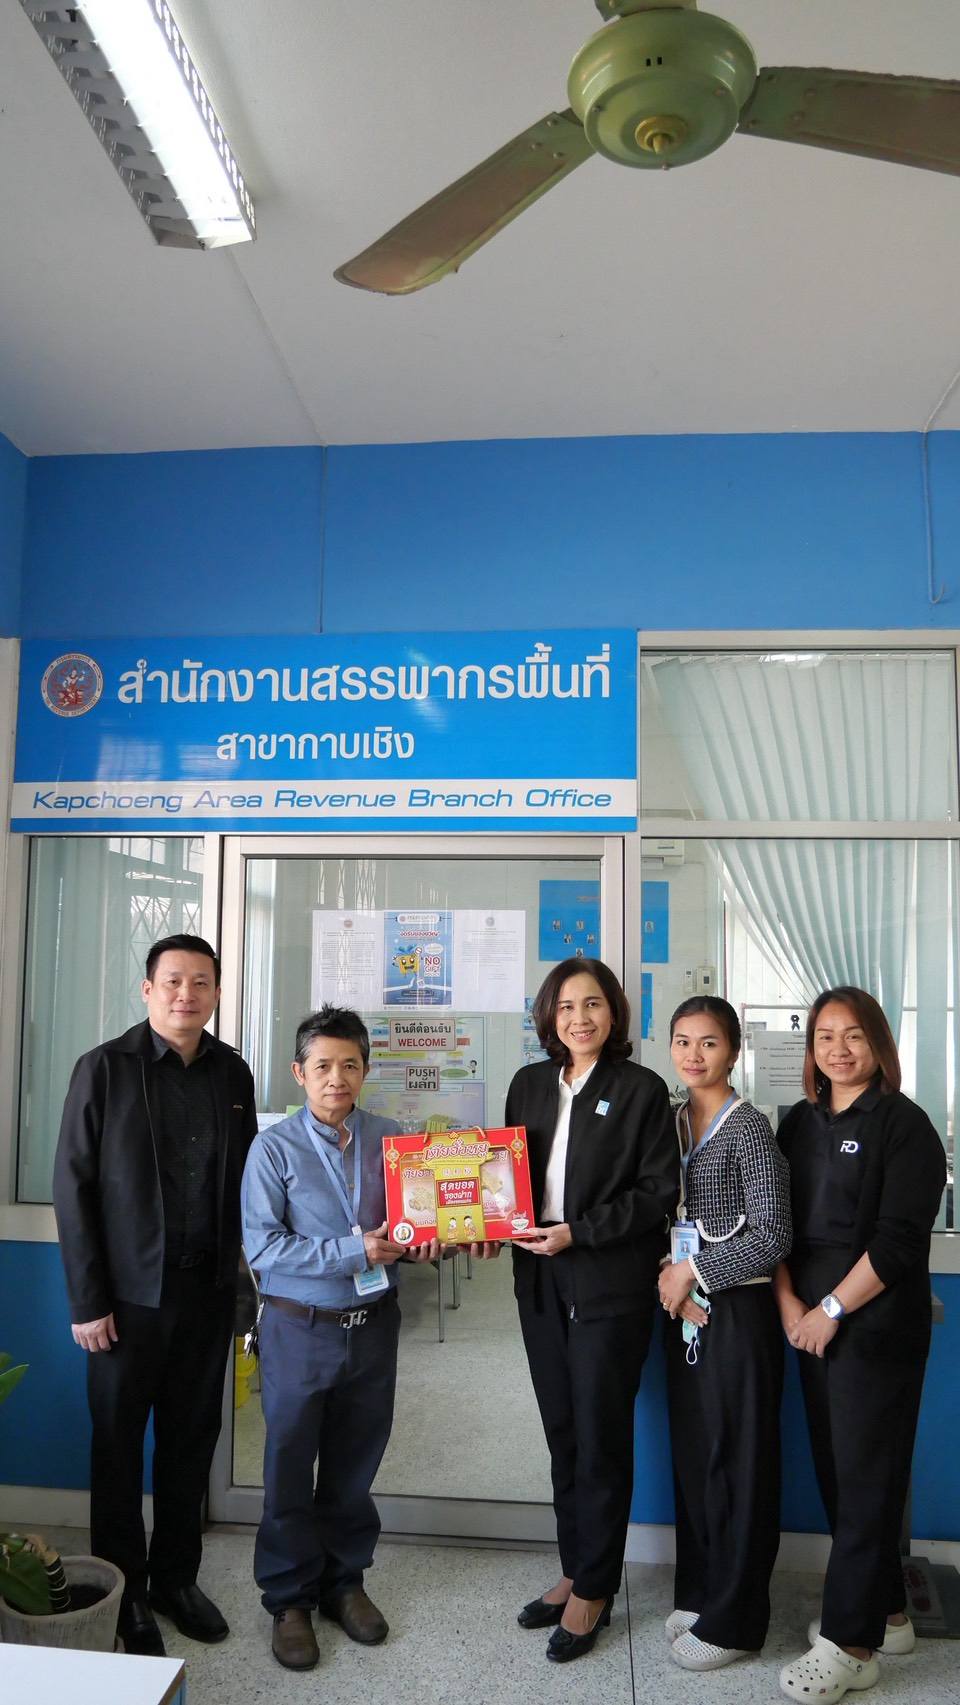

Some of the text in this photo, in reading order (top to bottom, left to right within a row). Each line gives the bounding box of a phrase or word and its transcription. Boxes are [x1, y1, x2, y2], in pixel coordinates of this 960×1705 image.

[117, 643, 611, 703] สำนักงานสรรพากรพื้นที่
[216, 726, 415, 760] สาขากาบเชิง
[32, 788, 612, 813] Kapchoeng Area Revenue Branch Office
[395, 1022, 452, 1034] ยินดีต้อนรับ
[398, 1038, 447, 1047] WELCOME
[408, 1068, 436, 1077] PUSH
[408, 1078, 436, 1089] ผลัก
[440, 1180, 475, 1193] สุดยอด
